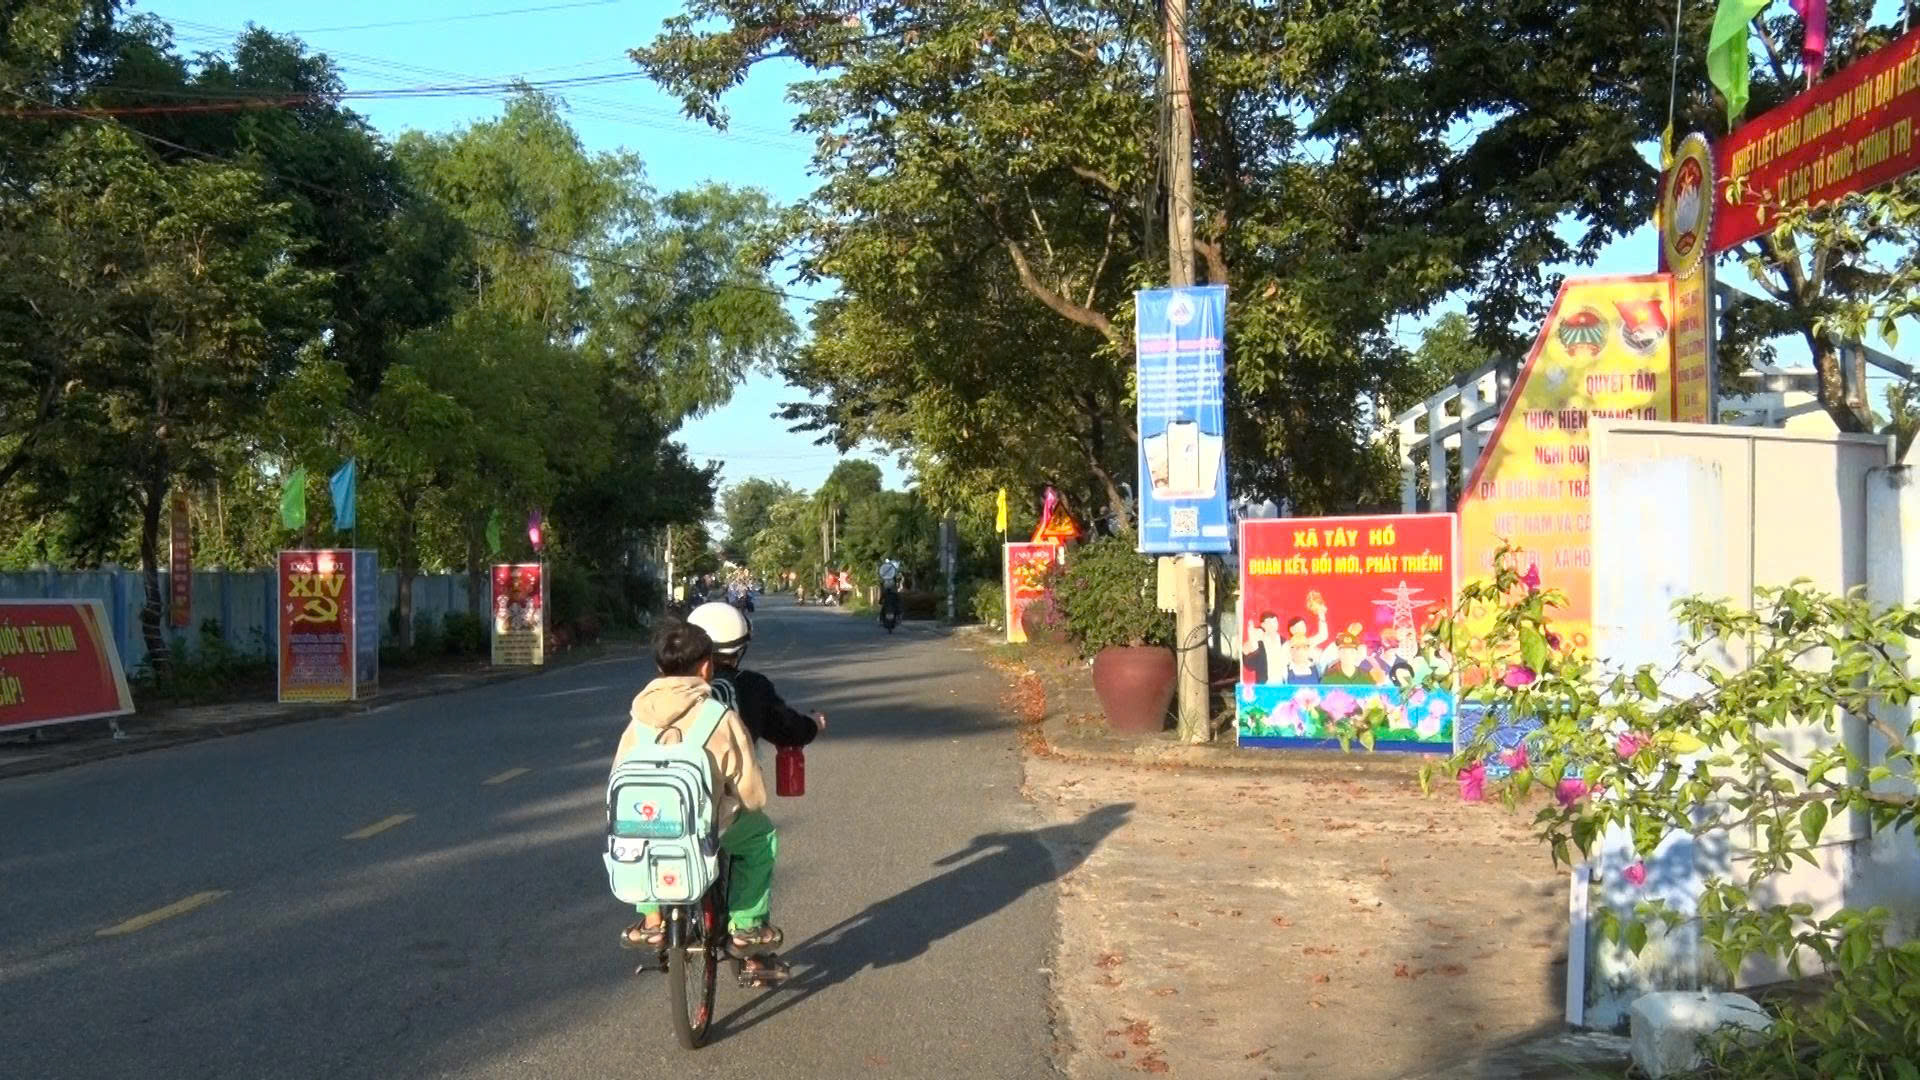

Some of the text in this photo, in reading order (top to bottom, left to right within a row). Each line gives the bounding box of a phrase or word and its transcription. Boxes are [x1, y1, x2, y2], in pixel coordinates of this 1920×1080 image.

[1757, 128, 1776, 169] LIỆT
[1777, 115, 1801, 156] CHÀO
[1803, 101, 1833, 144] MỪNG
[1834, 90, 1853, 131] ĐẠI
[1854, 75, 1873, 120] HỘI
[1875, 66, 1895, 110] ĐẠI
[1791, 162, 1810, 201] CÁC
[1812, 145, 1825, 192] TỔ
[1826, 141, 1854, 185] CHỨC
[1856, 127, 1891, 172] CHÍNH
[1893, 117, 1912, 158] TRỊ
[1630, 369, 1657, 393] TÂM
[1558, 406, 1587, 434] HIỆN
[1294, 528, 1318, 547] XÃ
[1324, 527, 1358, 547] TÂY
[1249, 557, 1282, 575] ĐOÀN
[1284, 553, 1309, 576] KẾT,
[1334, 555, 1363, 575] MỚI,
[1365, 552, 1398, 574] PHÁT
[1401, 547, 1443, 573] TRIỂN!
[288, 574, 346, 597] XIV
[21, 620, 49, 658] VIỆT
[47, 626, 78, 652] NAM
